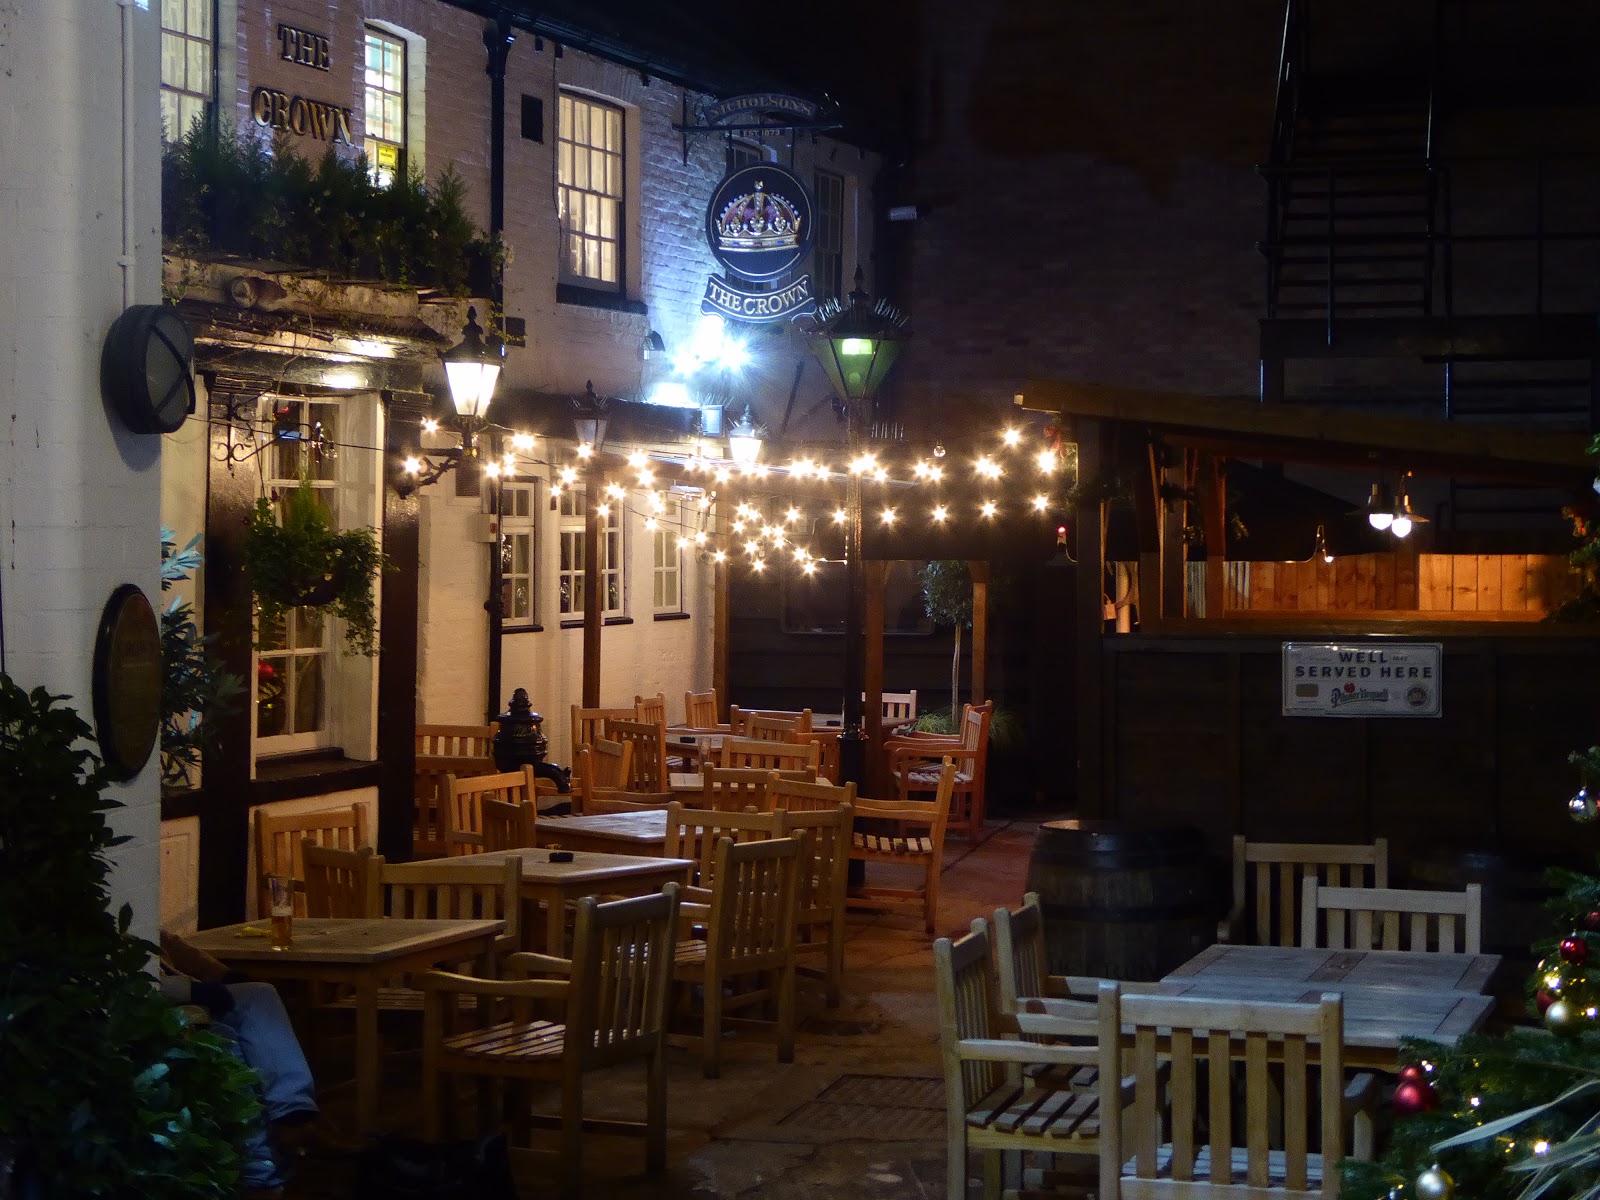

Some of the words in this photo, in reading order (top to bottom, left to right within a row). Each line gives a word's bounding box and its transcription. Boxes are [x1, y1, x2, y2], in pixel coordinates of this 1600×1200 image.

[277, 23, 330, 72] THE
[251, 86, 354, 146] CROWN
[709, 281, 741, 312] THE
[742, 280, 809, 315] CROWN
[1294, 666, 1371, 678] SERVED
[1380, 667, 1433, 678] HERE
[1339, 652, 1388, 663] WELL
